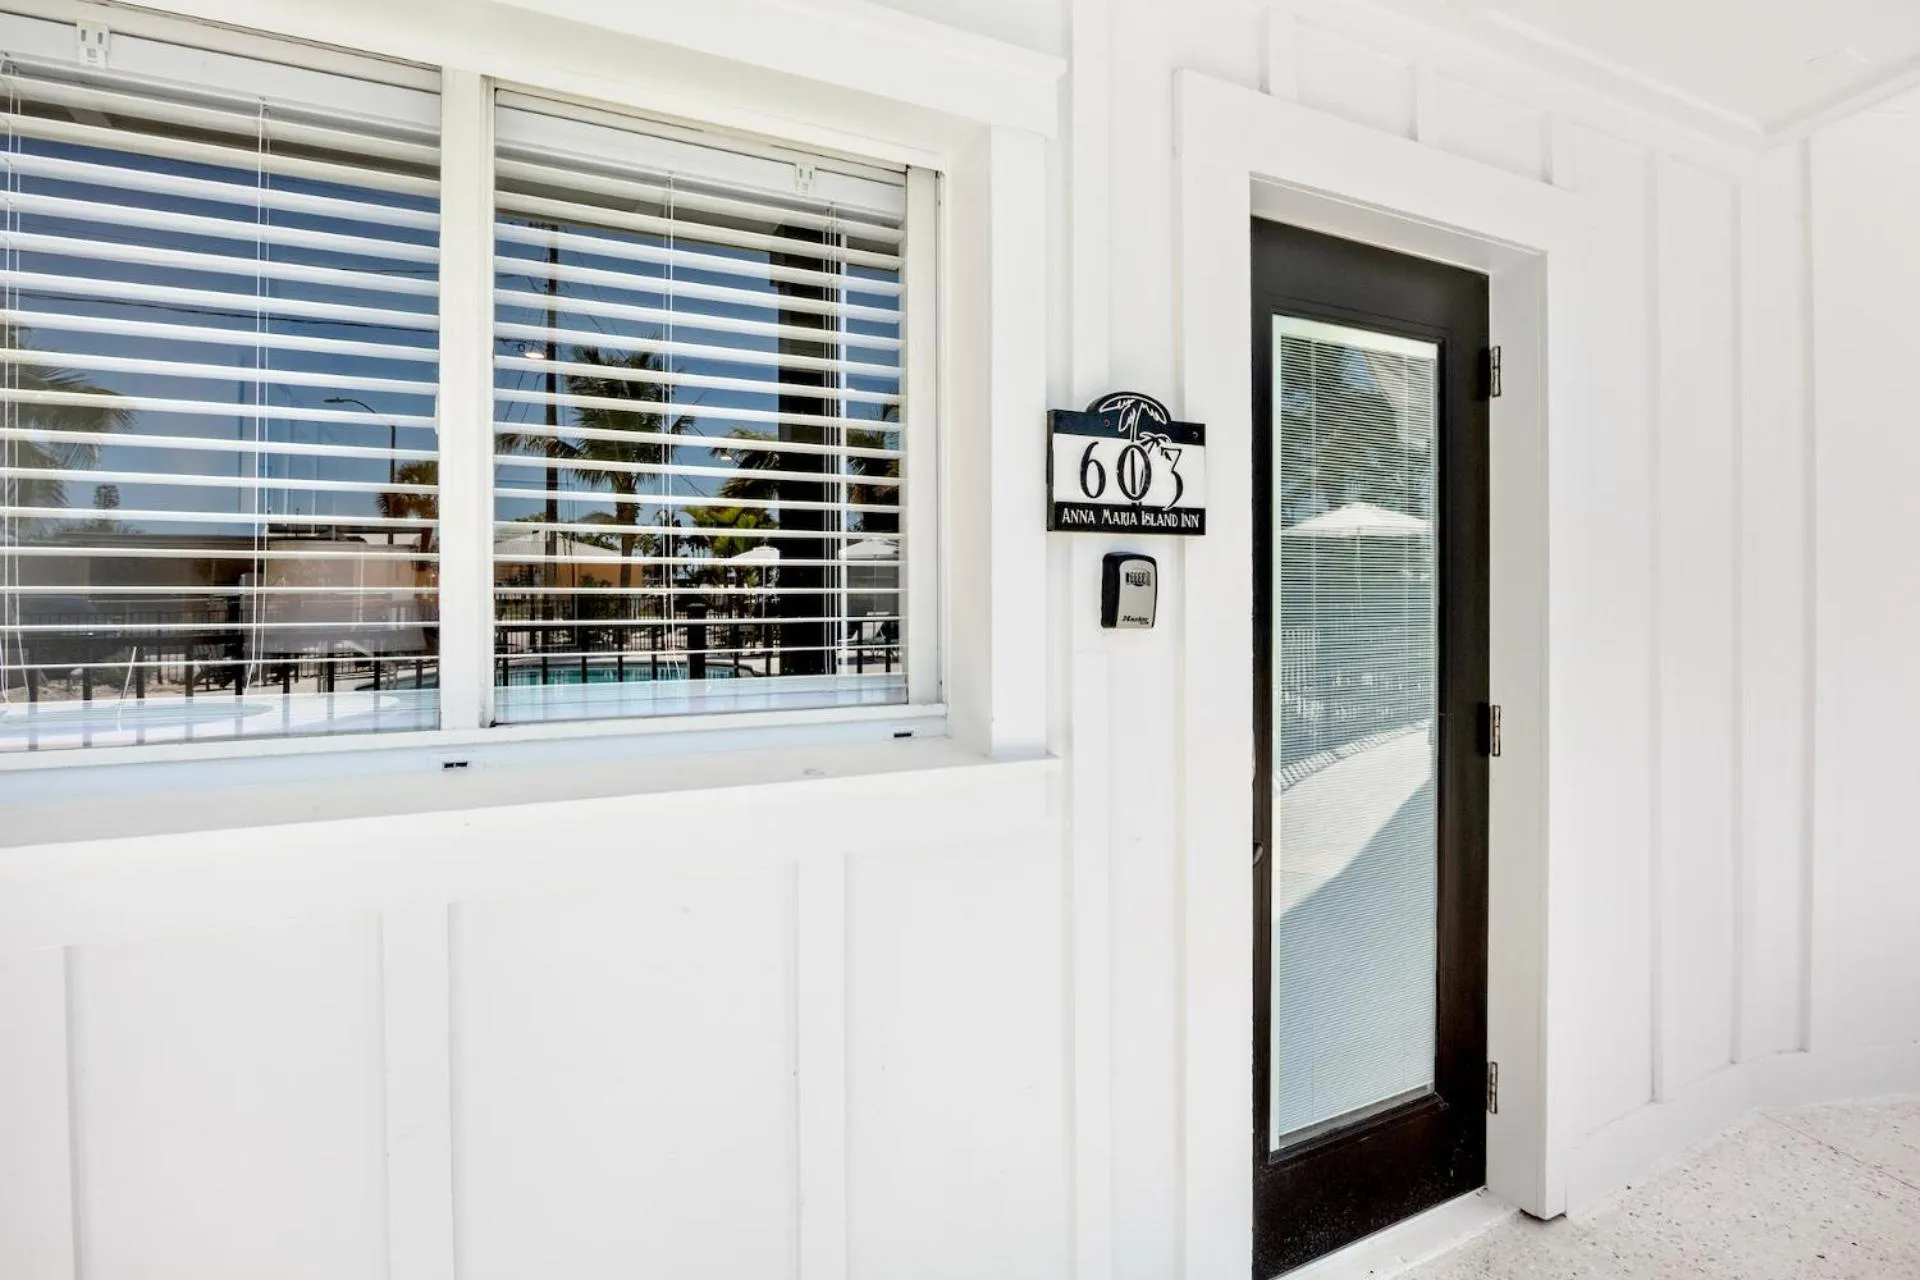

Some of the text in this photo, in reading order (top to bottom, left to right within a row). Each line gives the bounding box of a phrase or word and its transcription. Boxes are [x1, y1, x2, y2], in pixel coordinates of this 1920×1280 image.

[1080, 441, 1184, 511] 603
[1062, 508, 1200, 529] ANNA MARIA ISLAND INN
